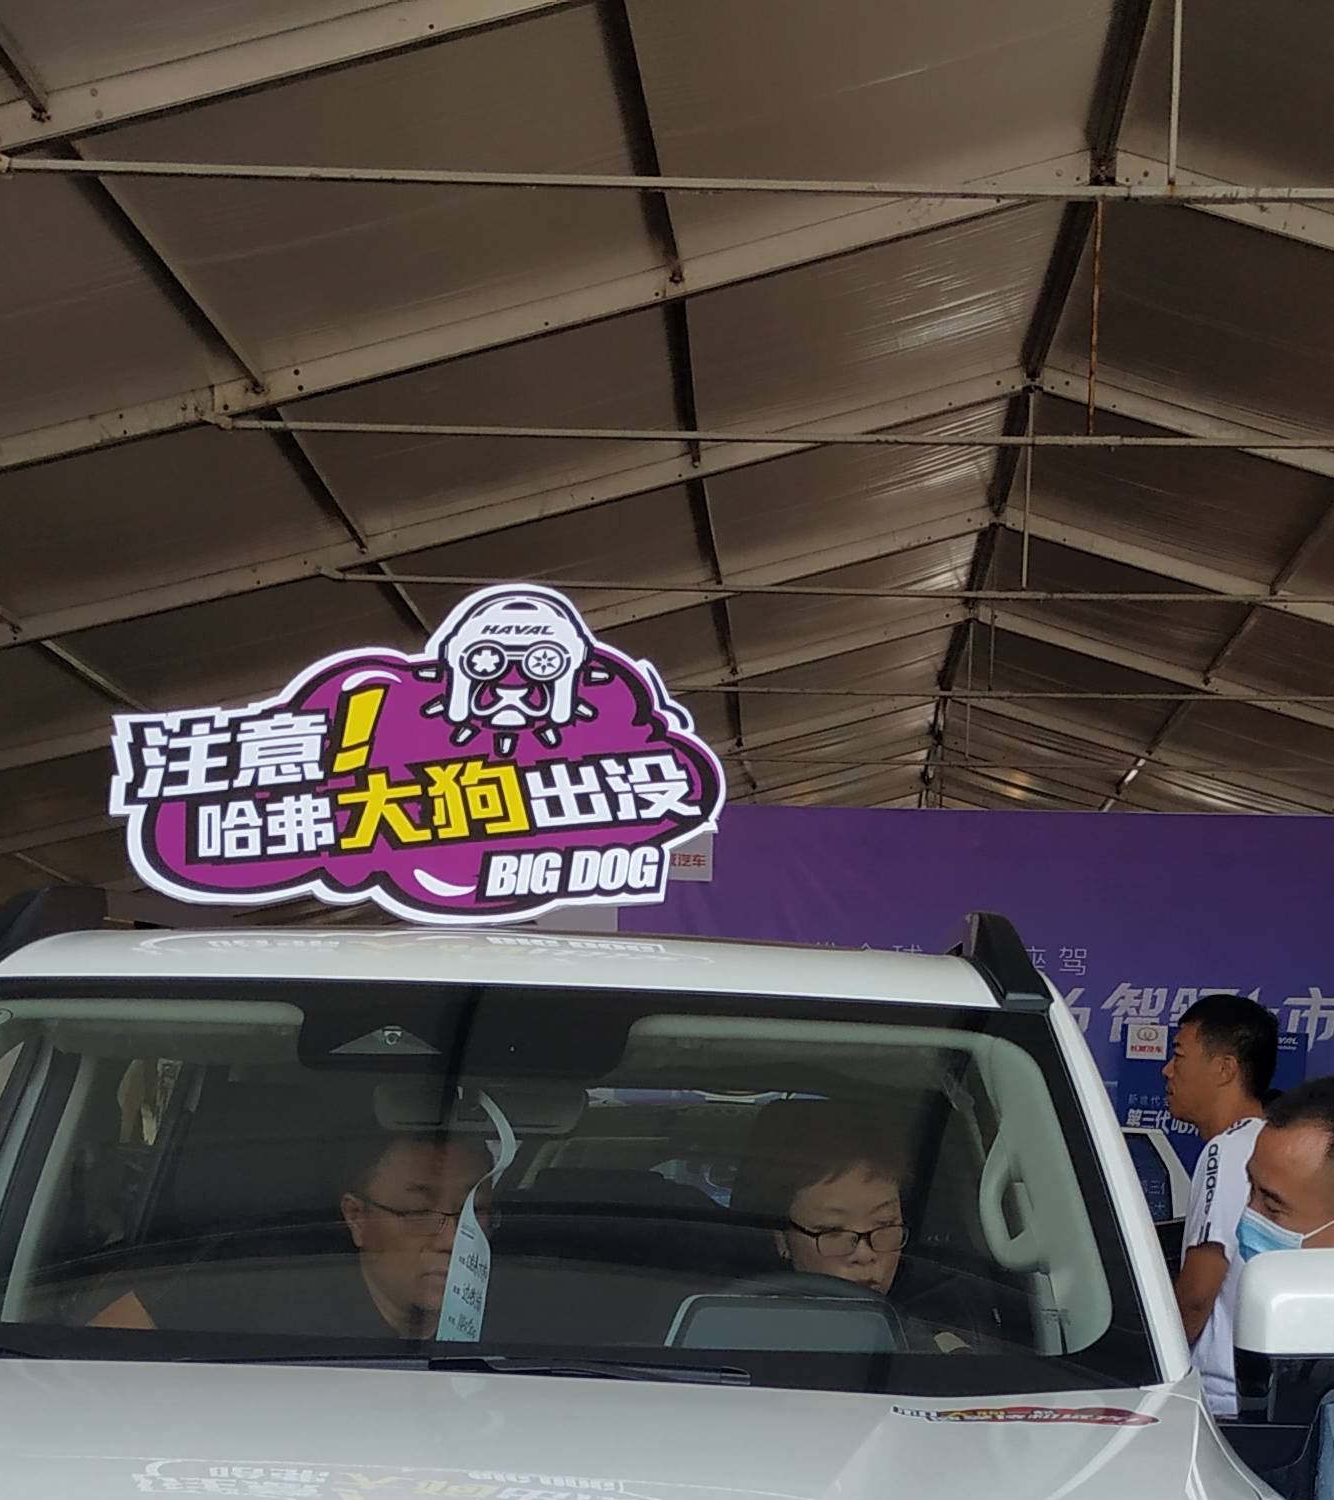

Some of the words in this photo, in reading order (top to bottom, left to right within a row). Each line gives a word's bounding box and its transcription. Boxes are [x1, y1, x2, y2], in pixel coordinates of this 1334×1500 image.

[480, 623, 556, 637] HAVAL
[198, 756, 702, 858] 哈弗大狗出没
[484, 851, 563, 897] BIG
[568, 847, 660, 893] DOG
